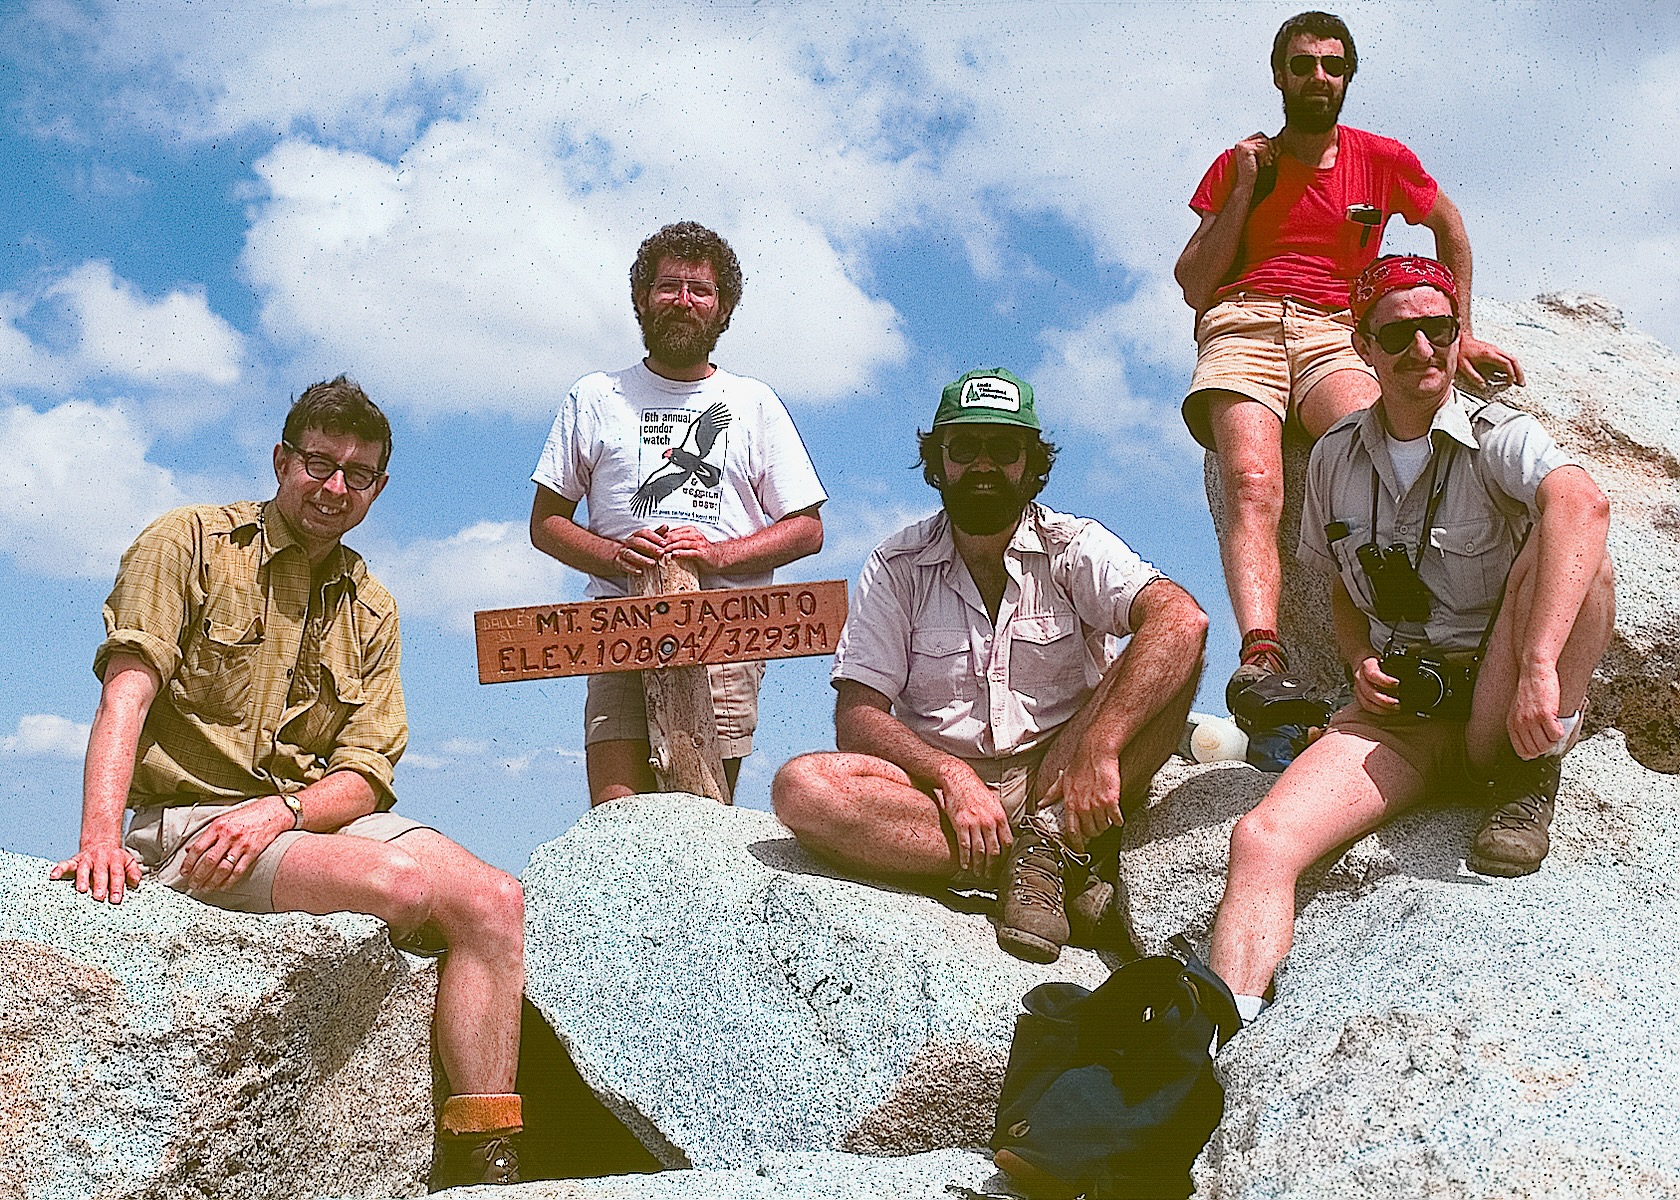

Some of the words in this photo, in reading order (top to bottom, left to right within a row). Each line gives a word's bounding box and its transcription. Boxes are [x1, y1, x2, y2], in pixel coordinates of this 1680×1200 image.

[644, 411, 659, 423] 6th
[662, 413, 691, 424] annual
[643, 422, 674, 434] condor
[643, 434, 671, 446] watch
[536, 608, 583, 636] MT.
[590, 603, 653, 635] SAN
[674, 590, 817, 628] JACINTO
[498, 643, 588, 675] ELEV.
